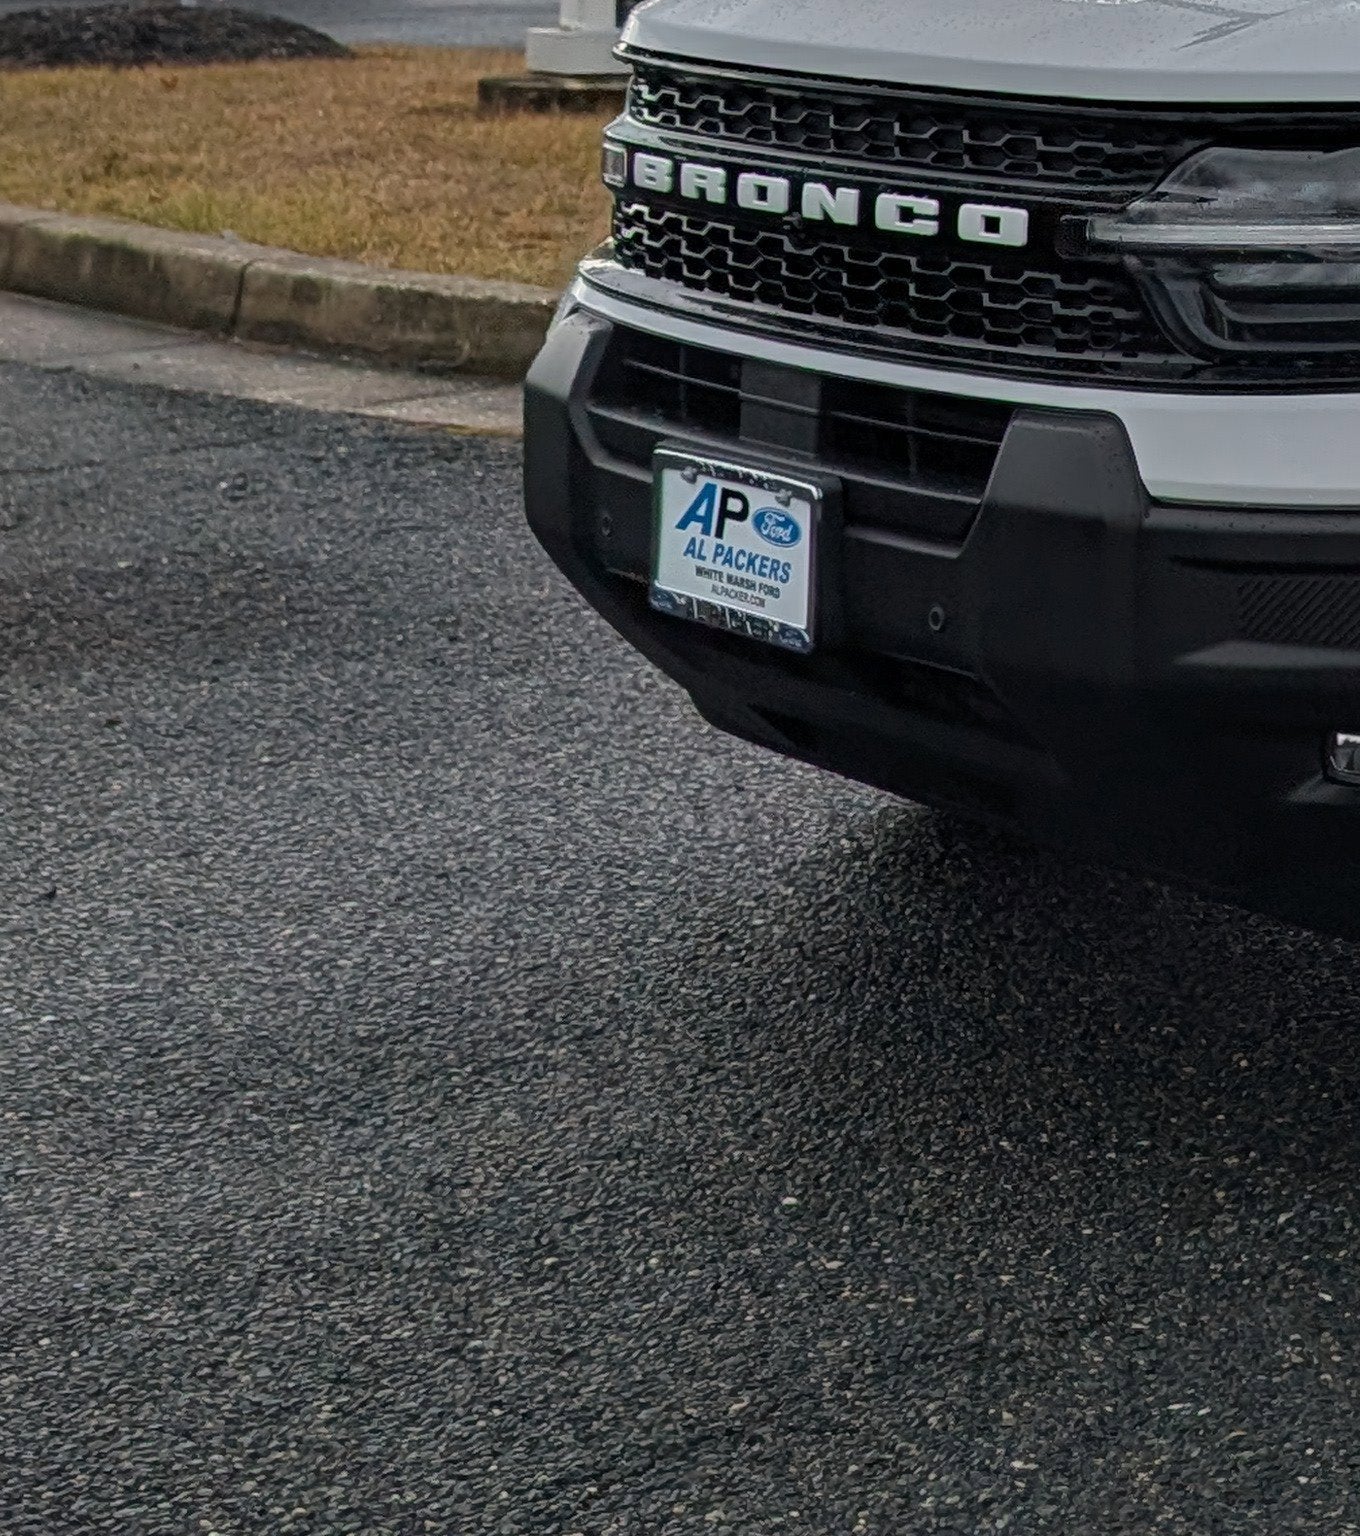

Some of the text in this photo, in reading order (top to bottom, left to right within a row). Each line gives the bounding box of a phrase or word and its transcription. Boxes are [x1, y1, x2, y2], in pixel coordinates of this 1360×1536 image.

[632, 151, 1029, 248] BRONCO
[675, 482, 750, 540] AP
[758, 512, 797, 544] Ford
[683, 536, 792, 584] AL PACKERS
[695, 564, 781, 600] WHITE MARSH FORD
